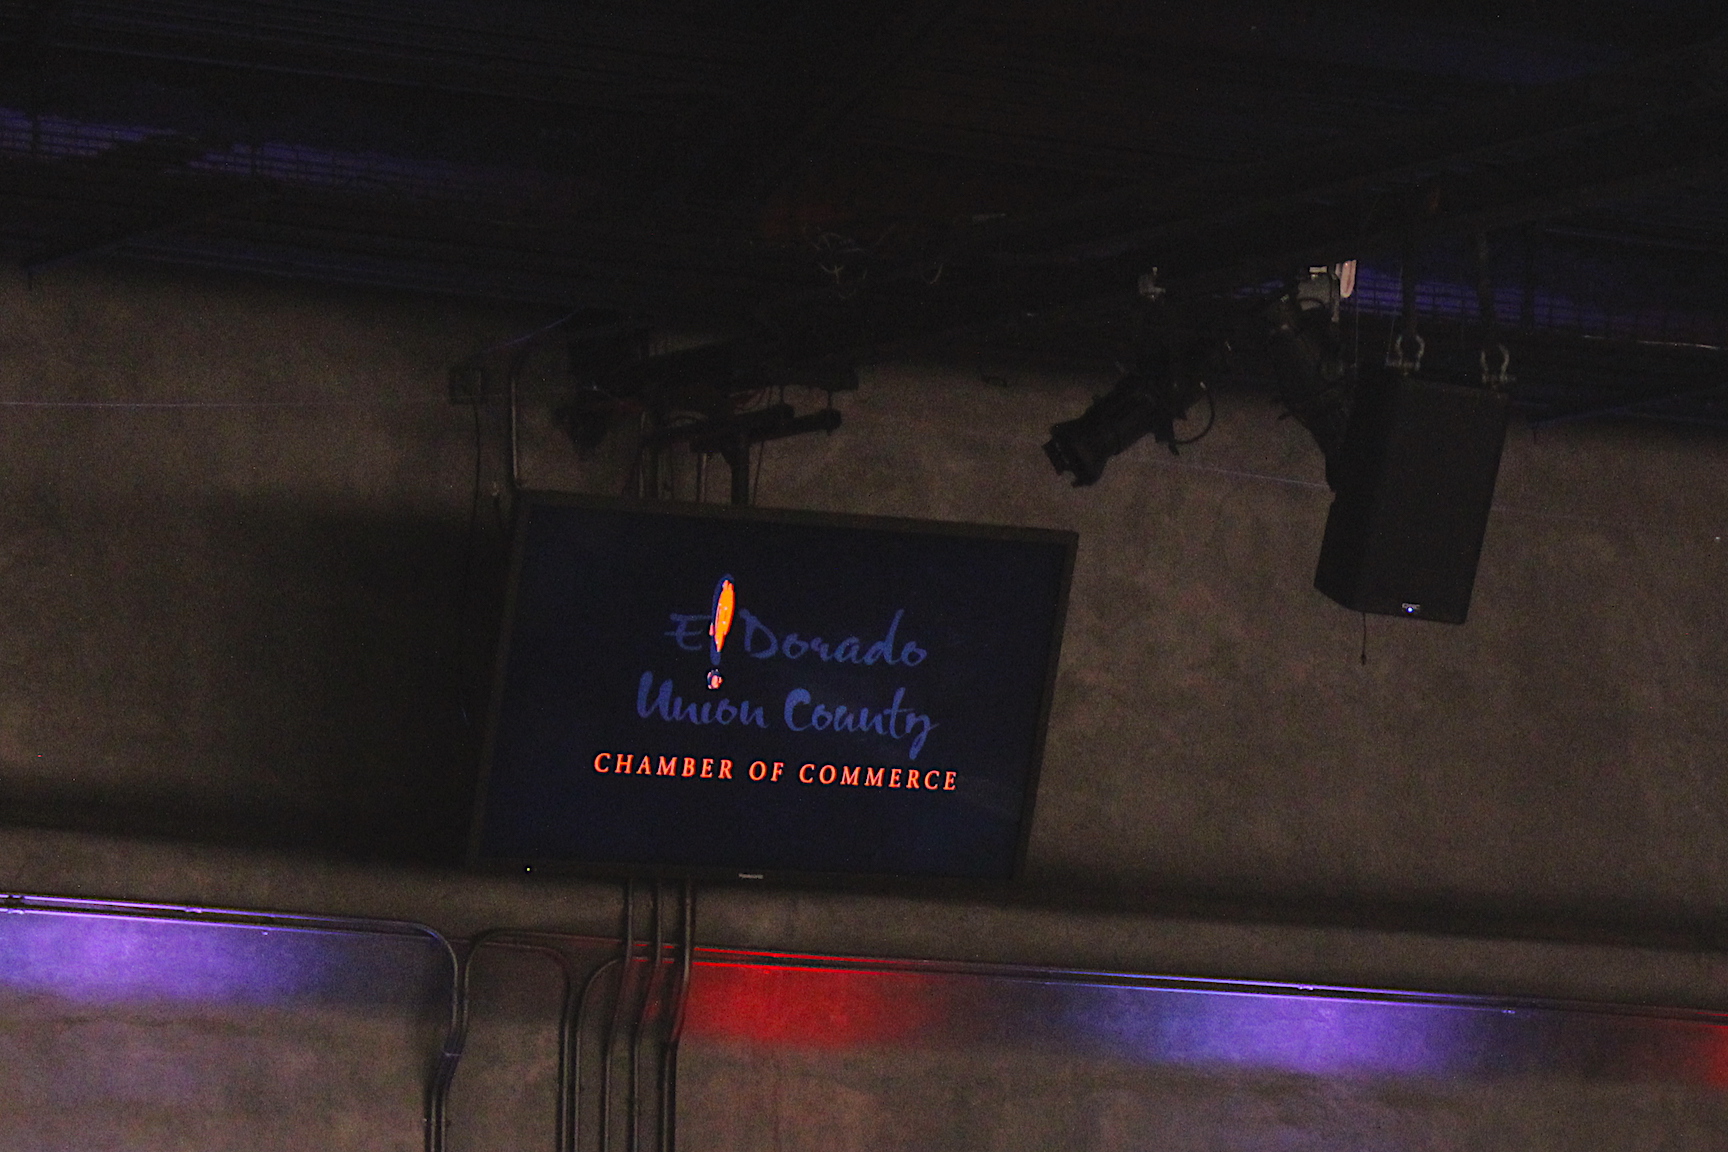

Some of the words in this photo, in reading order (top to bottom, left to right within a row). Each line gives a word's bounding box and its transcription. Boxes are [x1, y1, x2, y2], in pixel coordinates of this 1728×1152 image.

[740, 608, 928, 668] Dorado
[636, 671, 768, 729] Union
[784, 687, 939, 759] County
[593, 752, 734, 781] CHAMBER
[748, 760, 785, 783] OF
[799, 763, 959, 792] COMMERCE
